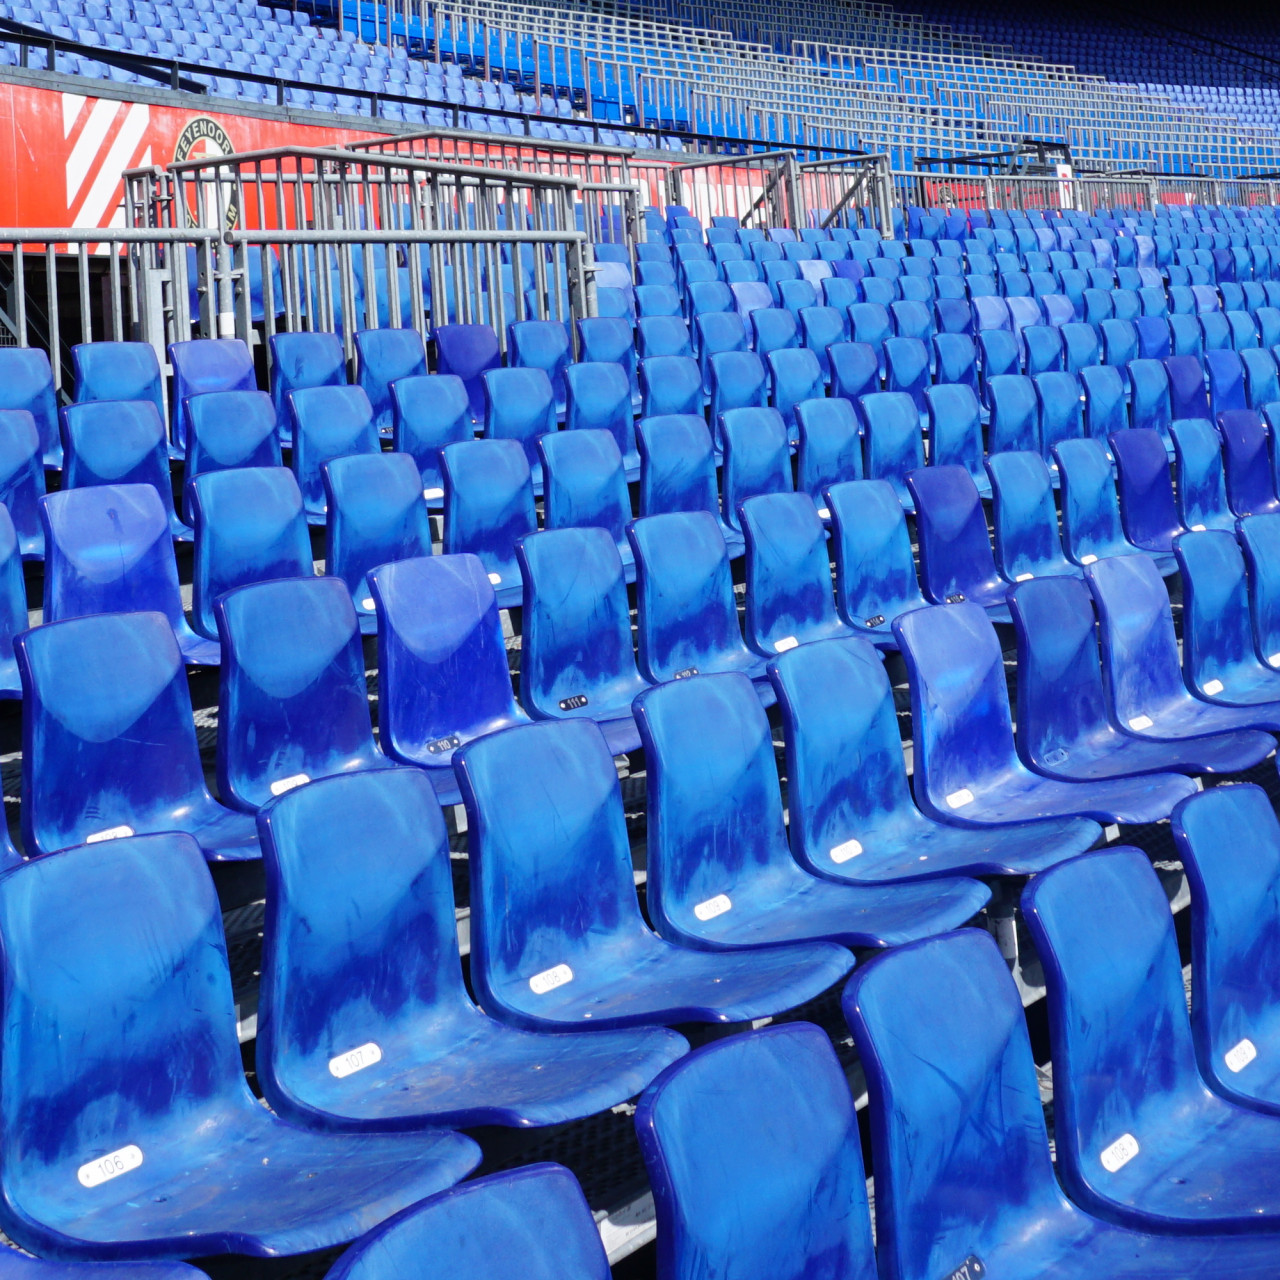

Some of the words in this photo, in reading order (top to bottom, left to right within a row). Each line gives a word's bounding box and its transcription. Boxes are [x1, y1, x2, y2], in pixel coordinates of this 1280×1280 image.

[177, 120, 230, 161] FEYENOOR
[567, 697, 581, 708] 111
[437, 740, 451, 751] 110
[345, 1051, 365, 1068] 107
[98, 1155, 124, 1177] 106
